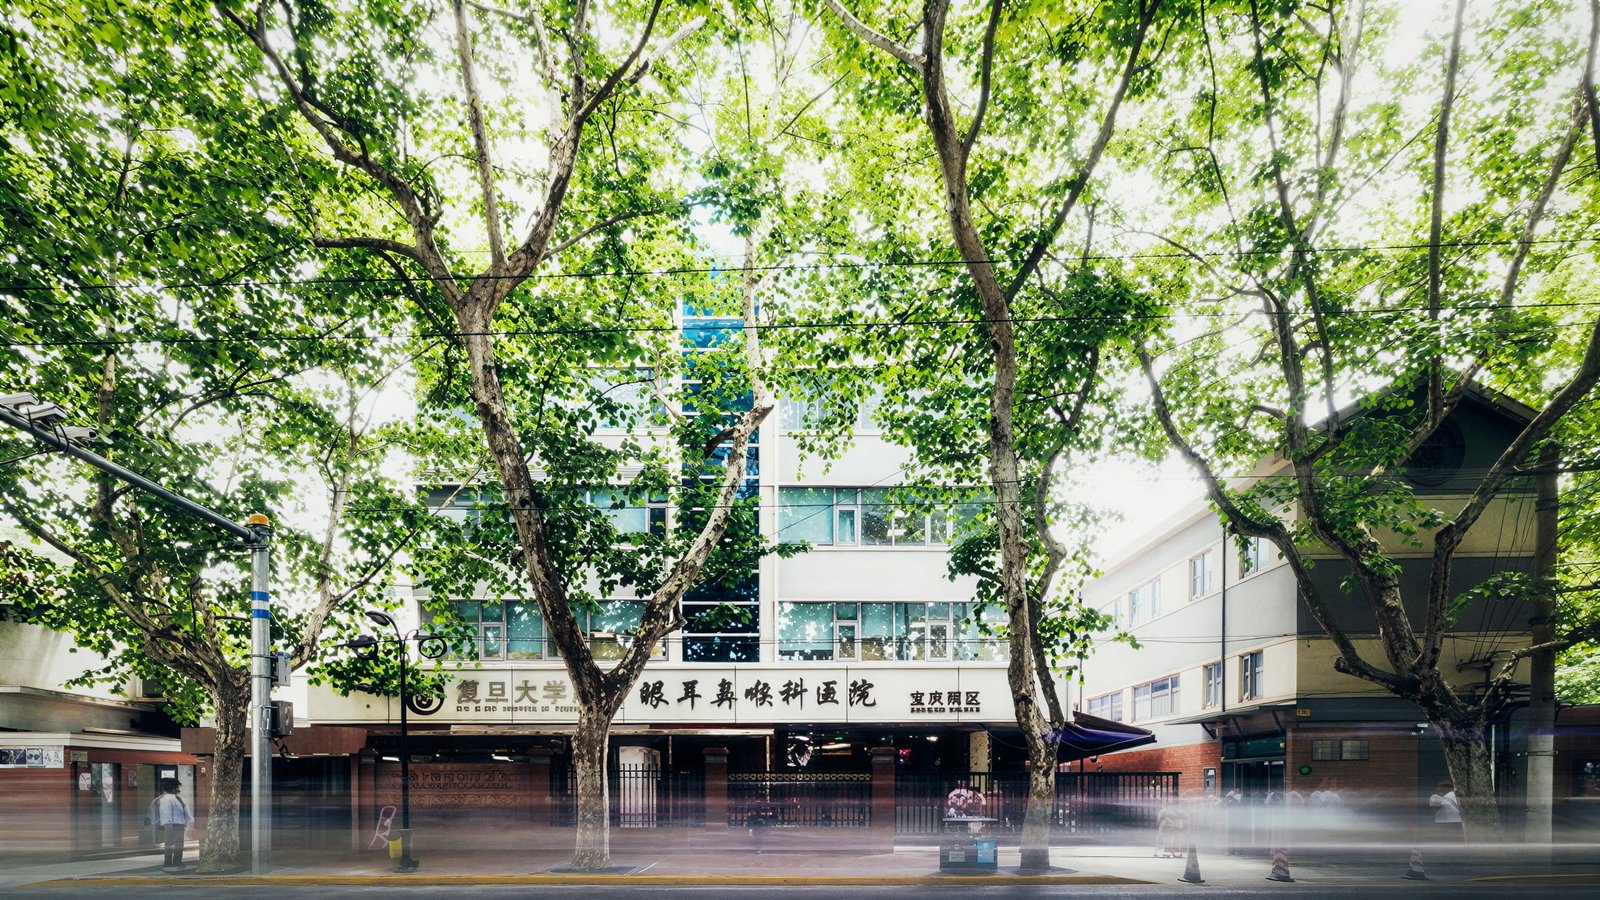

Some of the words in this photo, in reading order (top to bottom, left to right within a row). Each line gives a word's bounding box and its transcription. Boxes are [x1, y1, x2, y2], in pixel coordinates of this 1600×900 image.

[456, 680, 577, 705] 复旦大学
[639, 677, 877, 711] 眼耳鼻喉科医院
